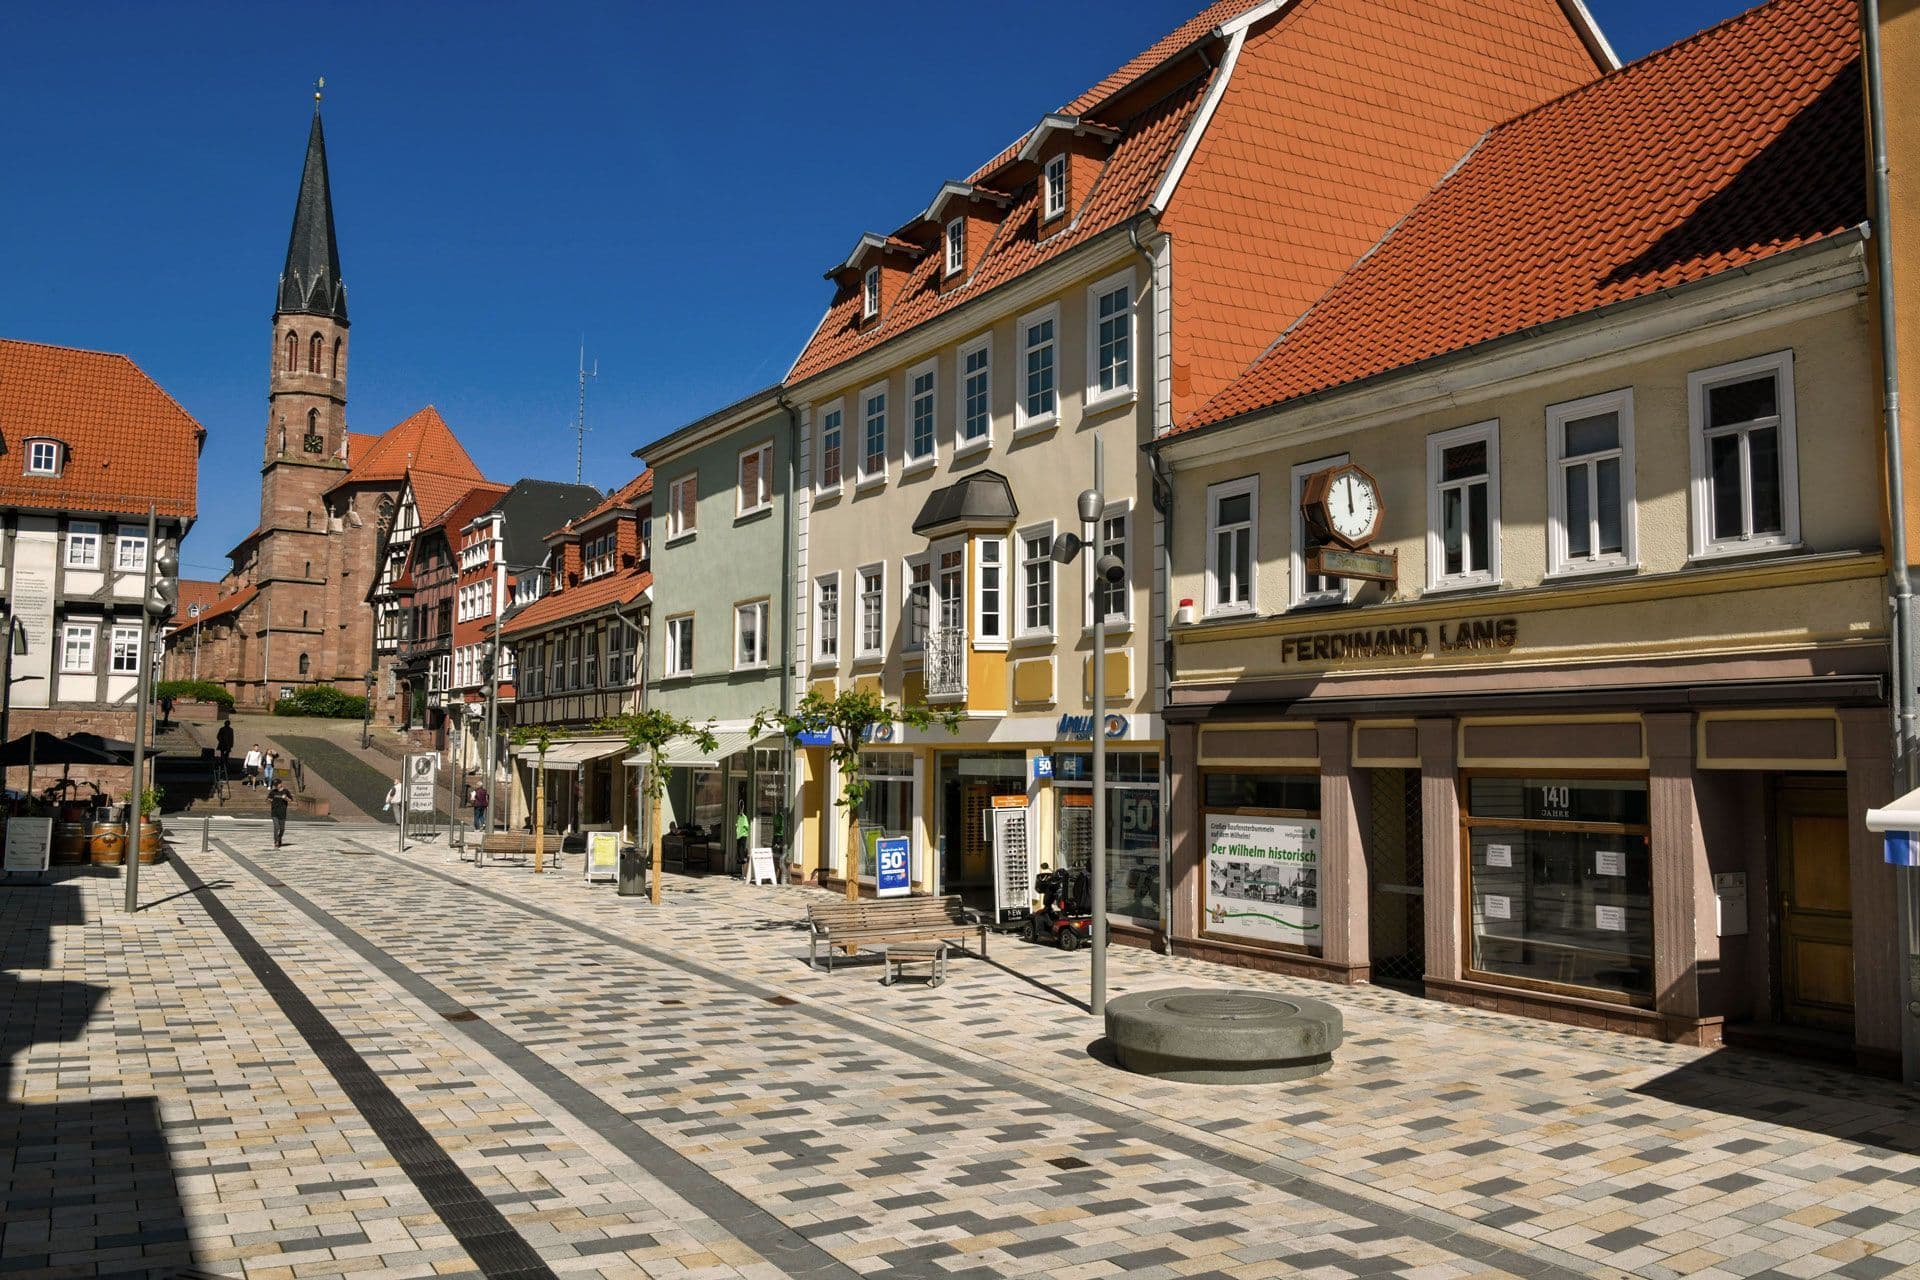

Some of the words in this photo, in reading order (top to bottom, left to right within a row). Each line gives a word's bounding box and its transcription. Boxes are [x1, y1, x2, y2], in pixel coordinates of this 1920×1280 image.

[1281, 626, 1428, 663] FERDINAND
[1440, 617, 1518, 651] LANG
[1039, 761, 1051, 771] 50
[1542, 785, 1569, 808] 140
[1122, 798, 1153, 832] 50
[1541, 809, 1570, 818] JAHRE
[1211, 843, 1227, 855] Der
[1229, 844, 1266, 858] Wilhelm
[1268, 846, 1316, 863] historisch
